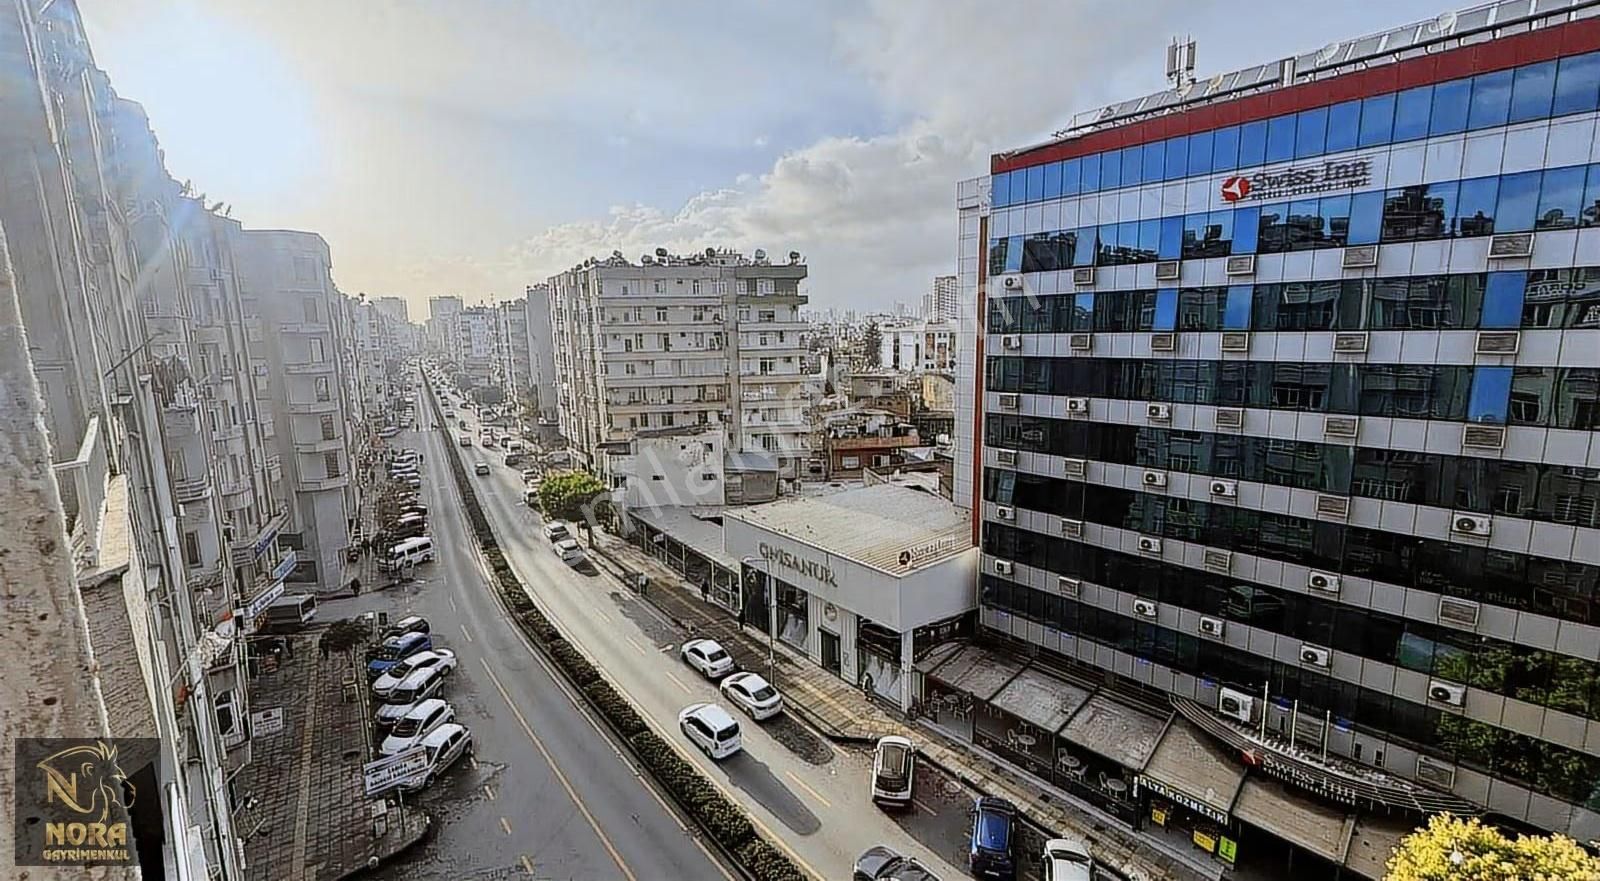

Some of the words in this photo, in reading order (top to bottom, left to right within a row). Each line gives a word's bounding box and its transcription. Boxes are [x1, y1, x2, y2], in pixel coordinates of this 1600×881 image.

[1251, 168, 1317, 192] Swiss
[1323, 160, 1370, 181] Inn
[1263, 753, 1315, 785] Swiss
[1322, 776, 1356, 799] Inn
